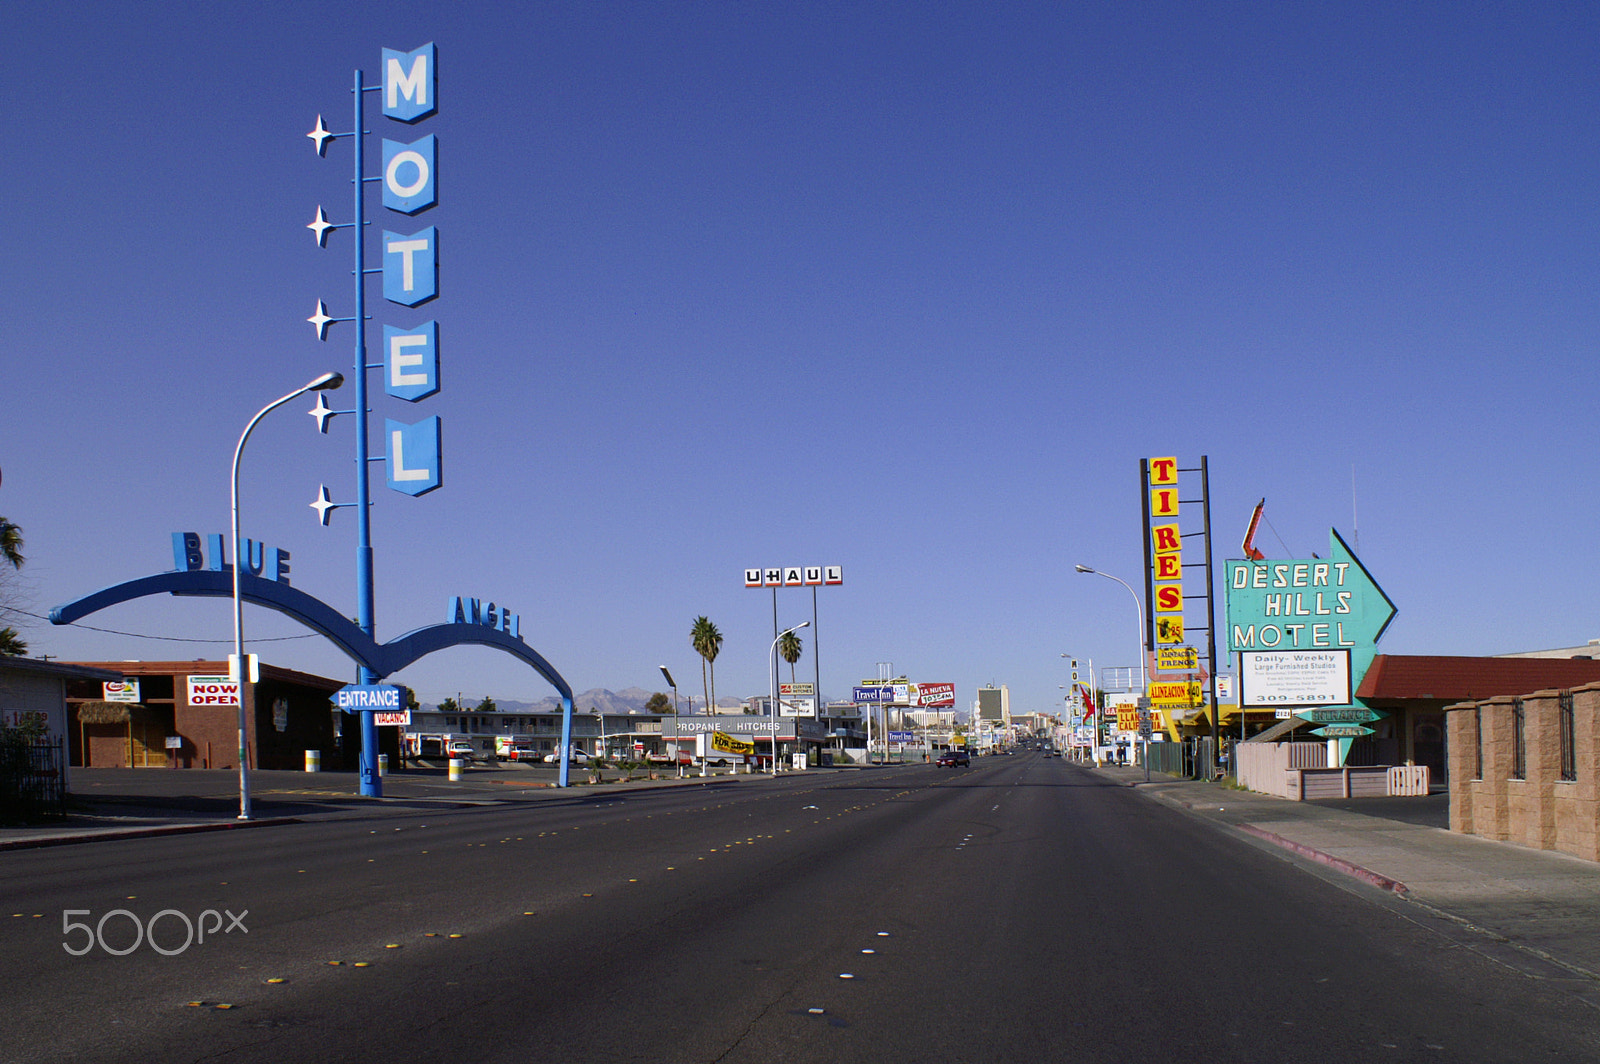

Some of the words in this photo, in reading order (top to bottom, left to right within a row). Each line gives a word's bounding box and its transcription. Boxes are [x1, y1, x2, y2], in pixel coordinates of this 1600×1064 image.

[386, 54, 430, 481] MOTEL
[1153, 459, 1179, 609] TIRES
[171, 532, 290, 586] BLUE
[1232, 562, 1350, 589] DESERT
[1265, 591, 1352, 616] HILLS
[446, 596, 523, 642] ANGEL
[1233, 622, 1355, 648] MOTEL
[1294, 654, 1335, 662] Weekly
[194, 685, 237, 694] NOW
[920, 688, 928, 696] LA
[930, 685, 952, 694] NUEVA
[1071, 660, 1080, 717] MOTEL
[1151, 686, 1185, 698] ALINEACION
[338, 690, 399, 706] ENTRANCE
[856, 689, 877, 700] Travel
[879, 689, 891, 700] Inn
[1256, 694, 1336, 702] 309-5891
[377, 712, 408, 723] VACANCY
[1312, 710, 1370, 721] ENTRANCE
[737, 721, 780, 731] HITCHES
[1141, 727, 1150, 735] 35
[714, 736, 729, 747] FOR
[889, 732, 902, 742] Travel
[904, 732, 912, 741] Inn
